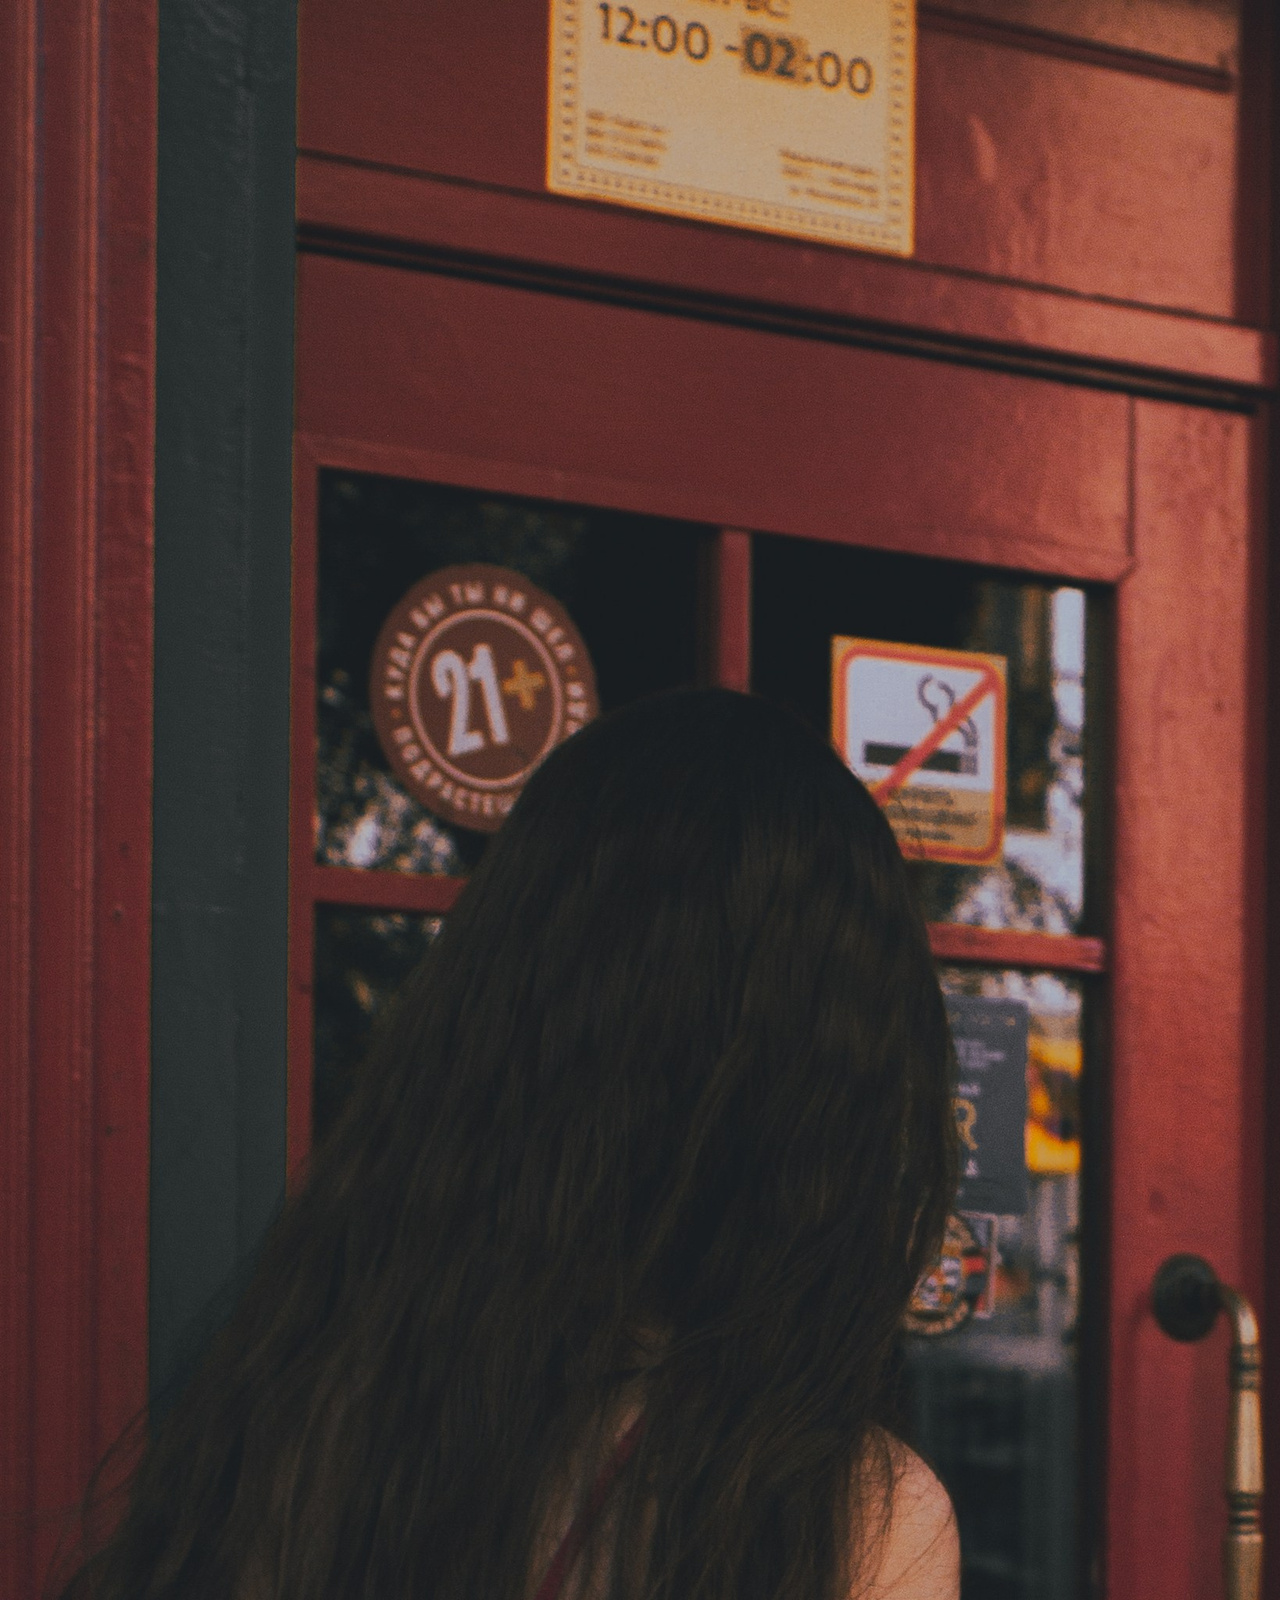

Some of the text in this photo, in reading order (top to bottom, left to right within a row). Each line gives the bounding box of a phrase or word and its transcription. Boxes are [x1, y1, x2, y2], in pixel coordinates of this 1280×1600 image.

[599, 3, 711, 62] 12:00
[450, 582, 484, 604] ТЫ
[431, 642, 546, 756] 21+
